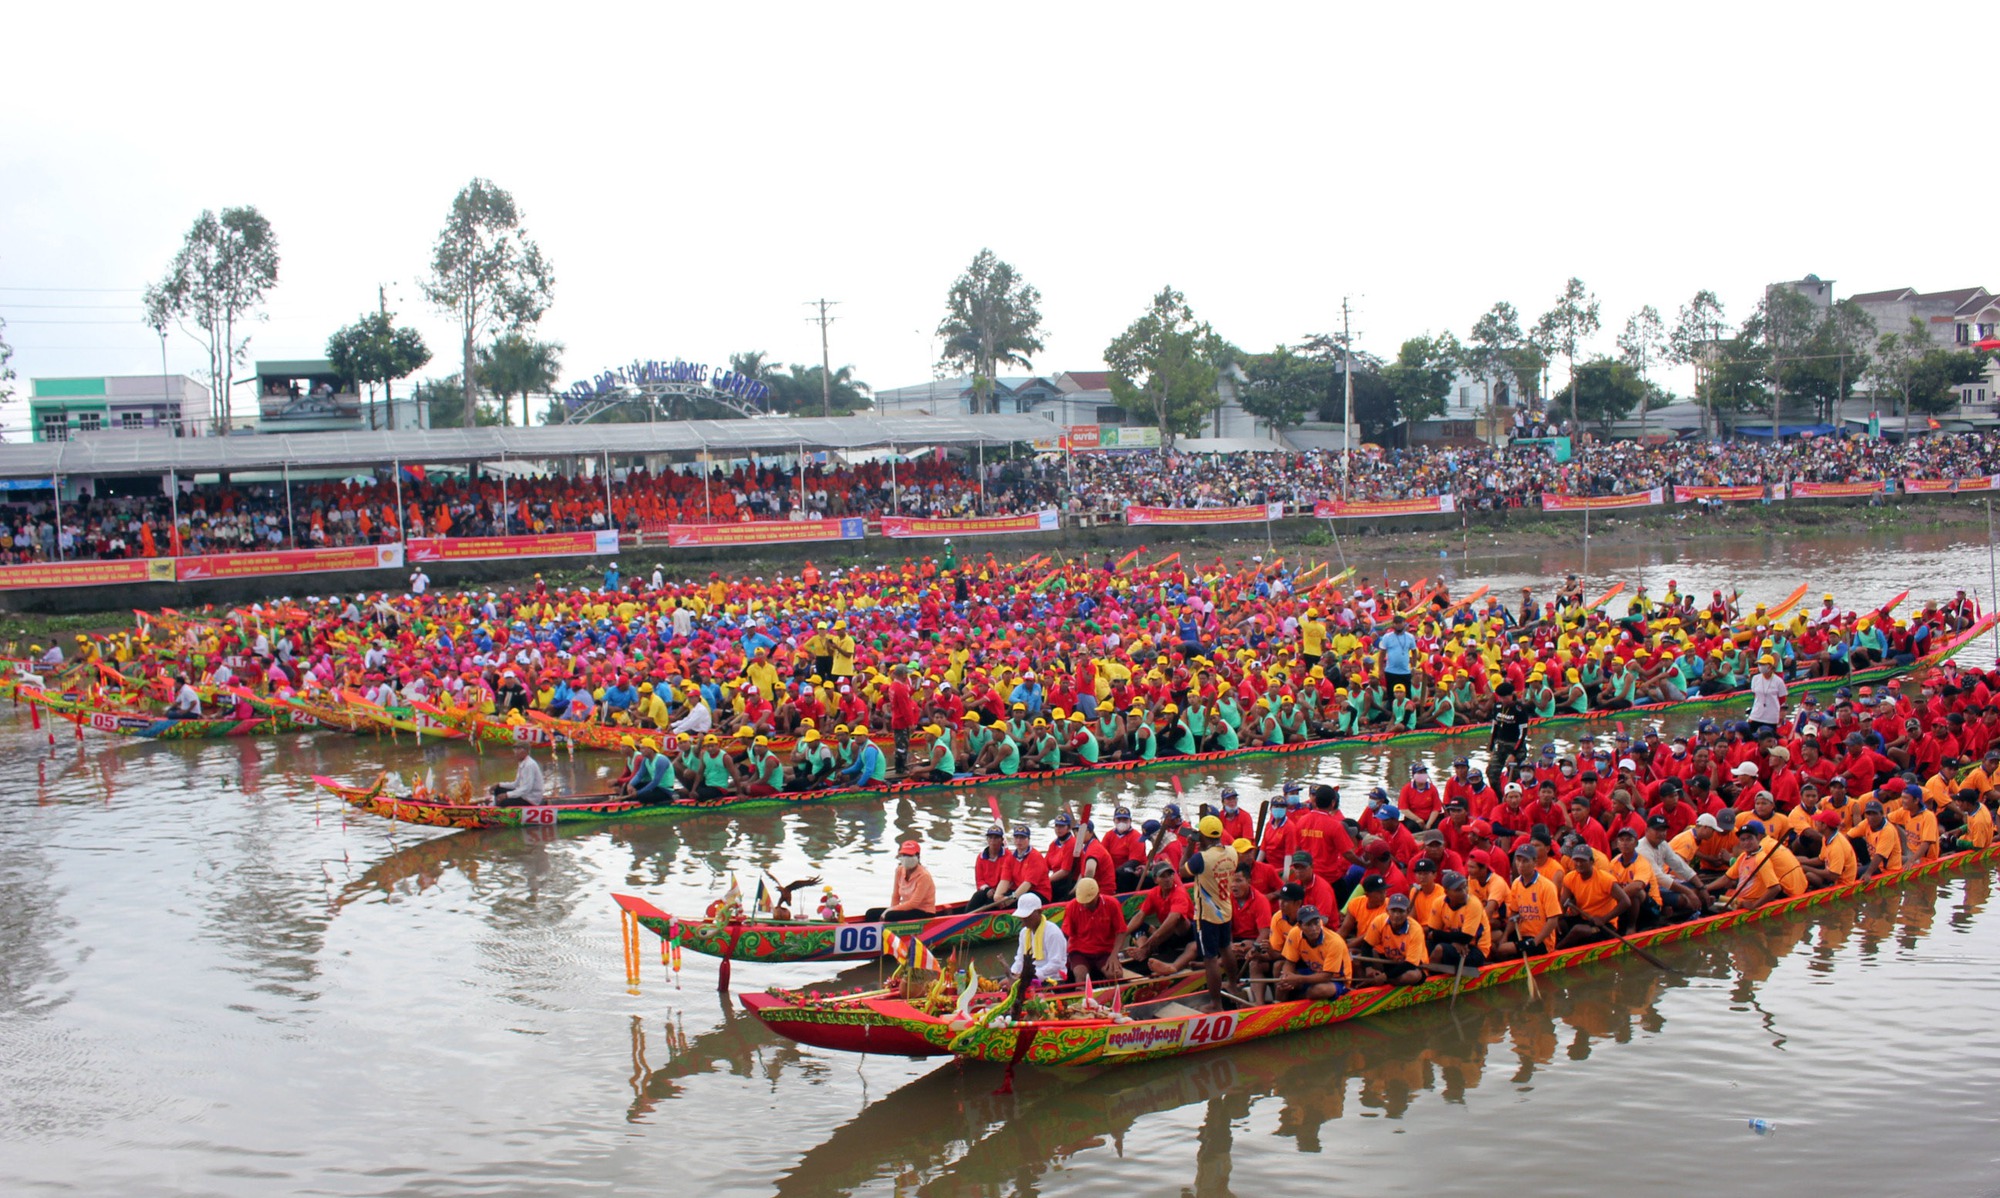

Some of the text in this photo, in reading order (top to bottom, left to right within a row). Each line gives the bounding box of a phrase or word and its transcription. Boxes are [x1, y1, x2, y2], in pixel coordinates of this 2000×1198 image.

[647, 361, 708, 381] MEKONG
[94, 714, 114, 728] 05
[293, 710, 314, 723] 24
[518, 727, 538, 741] 31
[526, 809, 553, 824] 26
[840, 927, 877, 951] 06
[1190, 1015, 1232, 1043] 40
